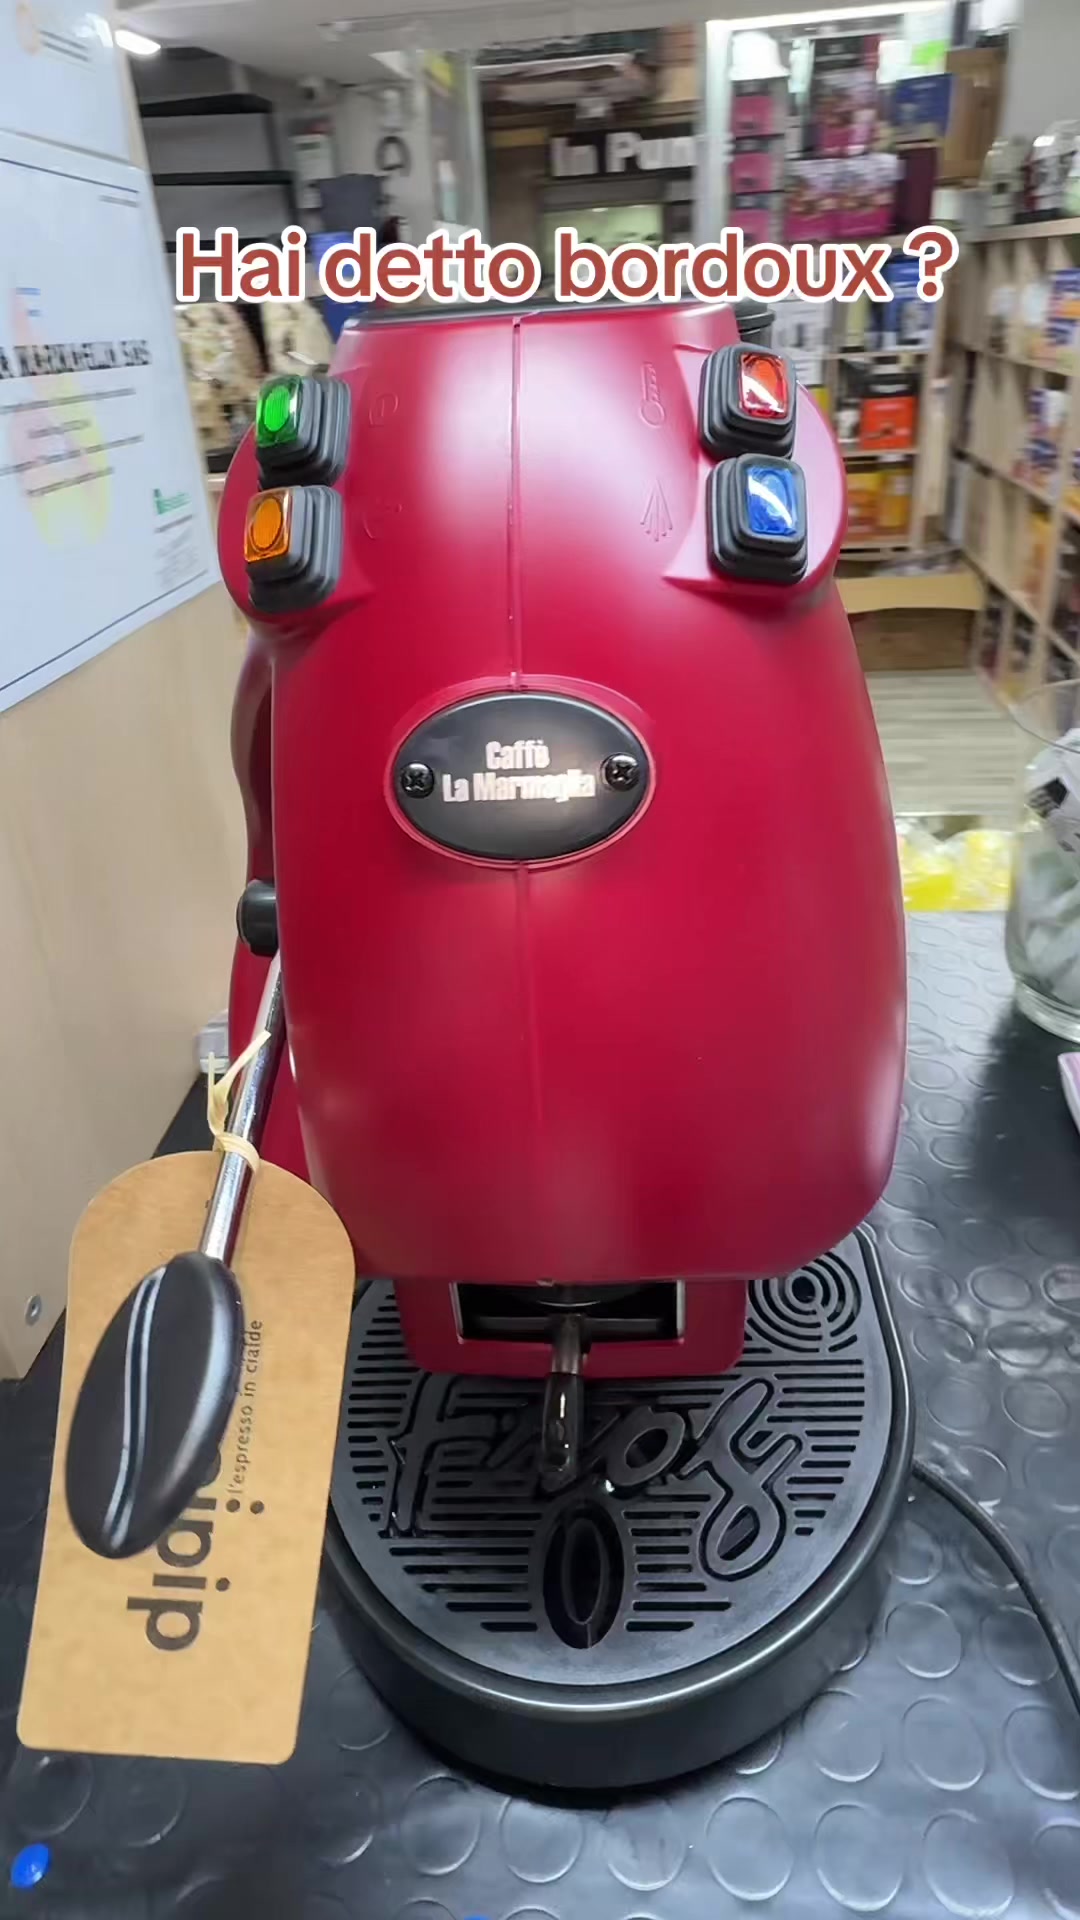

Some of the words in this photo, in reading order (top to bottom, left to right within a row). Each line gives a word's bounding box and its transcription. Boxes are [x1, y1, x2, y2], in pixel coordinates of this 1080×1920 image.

[485, 739, 551, 770] Caffè
[442, 773, 470, 803] La
[473, 768, 596, 803] Marmaglia
[240, 1381, 257, 1398] in
[228, 1405, 254, 1494] l'espresso
